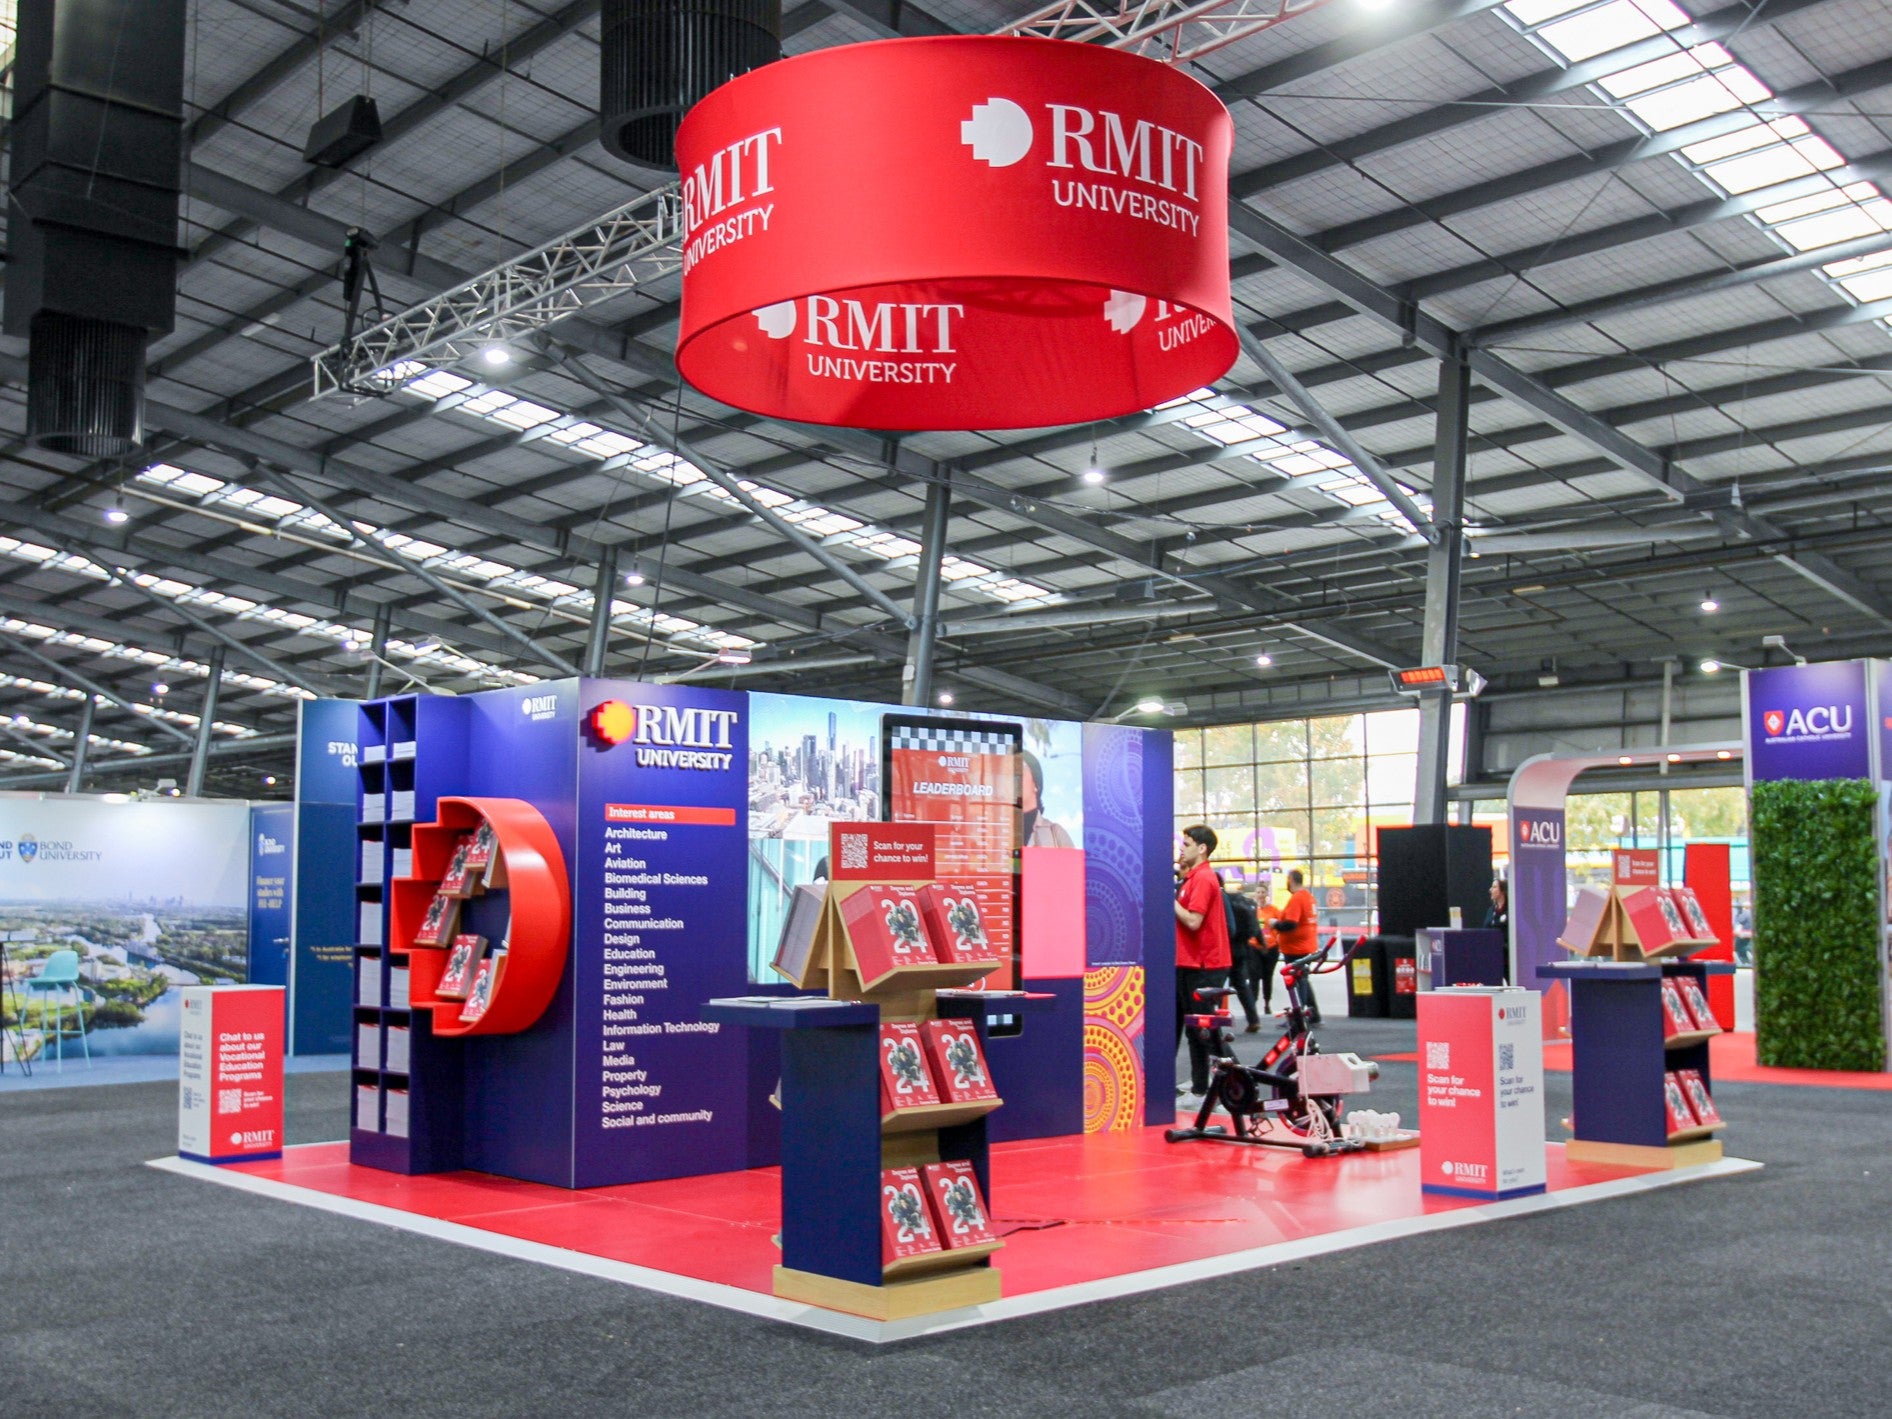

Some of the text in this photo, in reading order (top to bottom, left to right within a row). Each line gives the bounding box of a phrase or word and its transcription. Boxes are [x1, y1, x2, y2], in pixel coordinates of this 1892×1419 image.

[1046, 103, 1203, 202] RMIT
[683, 127, 782, 244] RMIT
[1052, 181, 1200, 237] UNIVERSITY
[804, 296, 964, 353] RMIT
[807, 354, 956, 384] UNIVERSITY
[531, 695, 558, 712] RMIT
[633, 704, 738, 748] RMIT
[1786, 704, 1852, 736] ACU
[636, 748, 733, 770] UNIVERSITY
[947, 756, 970, 768] RMIT
[913, 782, 994, 796] LEADERBOARD
[608, 806, 675, 820] Interest areas
[605, 827, 668, 840] Architecture
[1530, 821, 1560, 844] ACU
[40, 840, 72, 850] BOND
[605, 842, 622, 854] Art
[873, 840, 924, 852] Scan for your
[40, 850, 102, 861] UNIVERSITY
[873, 853, 928, 862] chance to win!
[605, 857, 646, 869] Aviation
[605, 872, 708, 886] Biomedical Sciences
[605, 888, 646, 901] Building
[604, 903, 651, 914] Business
[604, 918, 684, 930] Communication
[604, 934, 640, 946] Design
[604, 948, 656, 960] Education
[604, 963, 664, 976] Engineering
[604, 978, 668, 990] Environment
[604, 994, 644, 1006] Fashion
[604, 1009, 637, 1020] Health
[1506, 1006, 1526, 1019] RMIT
[603, 1022, 720, 1036] Information Technology
[220, 1032, 241, 1042] Chat
[220, 1042, 245, 1052] about
[603, 1040, 624, 1052] Law
[219, 1051, 266, 1062] Vocational
[602, 1056, 635, 1066] Media
[219, 1062, 264, 1072] Education
[219, 1072, 262, 1082] Programs
[602, 1070, 647, 1082] Property
[1428, 1074, 1465, 1085] Scan for
[1500, 1076, 1524, 1086] Scan for
[602, 1084, 662, 1098] Psychology
[1428, 1086, 1482, 1097] your chance
[1501, 1086, 1534, 1096] your chance
[602, 1101, 644, 1113] Science
[1428, 1096, 1456, 1108] to win!
[602, 1110, 713, 1128] Social and community
[244, 1130, 274, 1142] RMIT
[1455, 1162, 1488, 1178] RMIT
